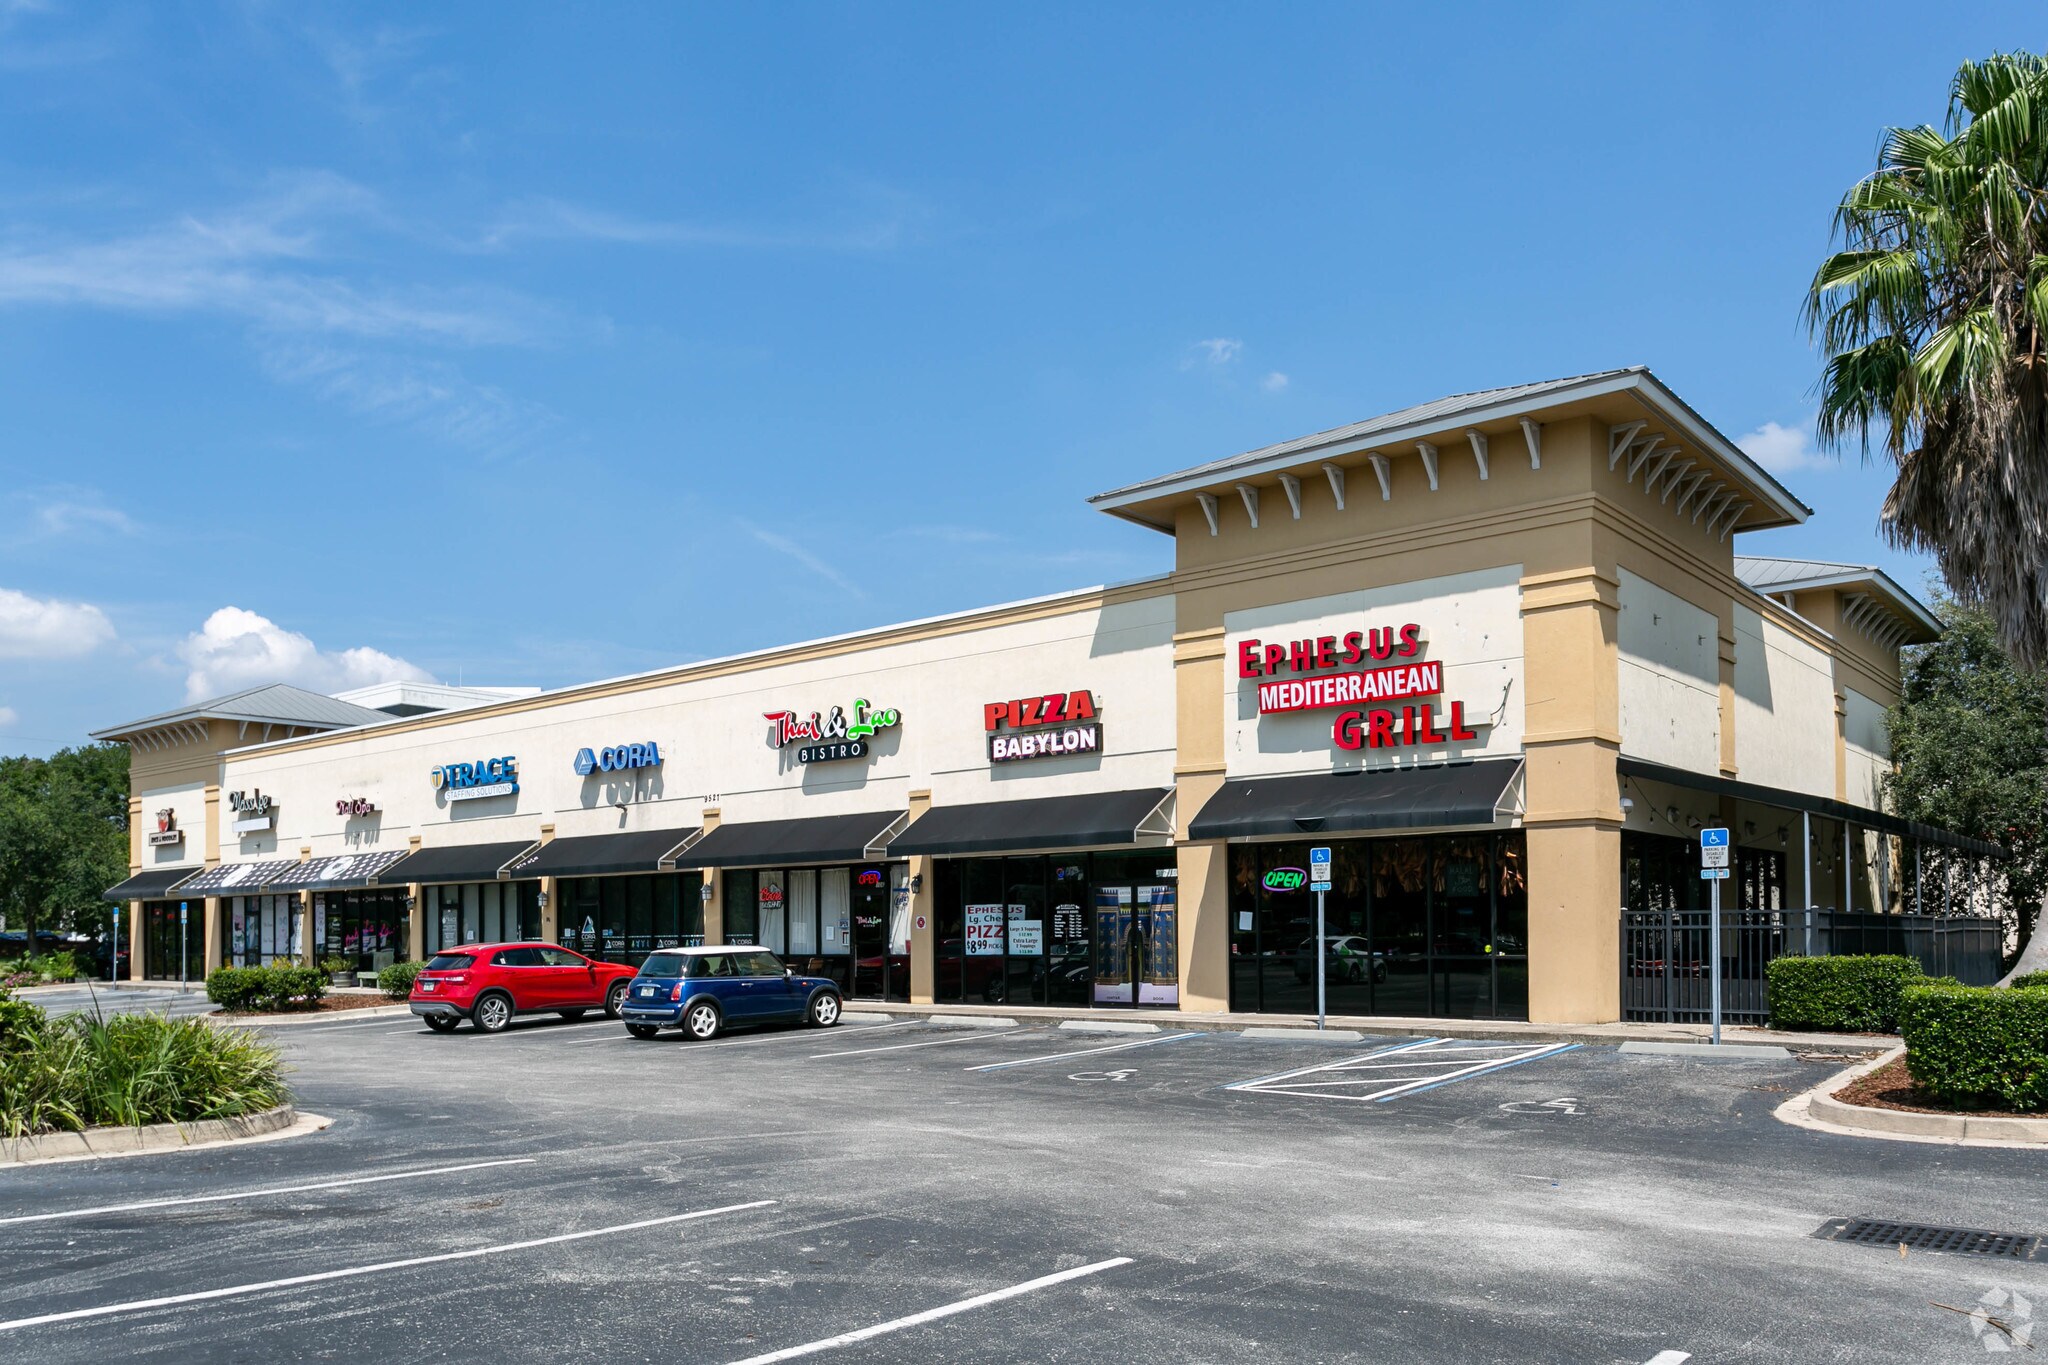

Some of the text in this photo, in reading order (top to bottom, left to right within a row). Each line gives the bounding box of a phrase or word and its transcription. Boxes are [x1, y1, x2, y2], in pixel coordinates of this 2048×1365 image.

[1238, 623, 1420, 679] EPHESUS
[1261, 664, 1438, 711] MEDITERRANEAN
[762, 697, 899, 748] Thai & Lao
[984, 689, 1096, 732] PIZZA
[1333, 700, 1477, 751] GRILL
[600, 741, 660, 772] CORA
[801, 743, 861, 762] BISTRO
[993, 727, 1096, 759] BABYLON
[446, 756, 516, 788] TRACE
[446, 784, 511, 800] STAFFING SOLUTIONS
[858, 873, 879, 885] OPEN
[1265, 871, 1303, 888] OPEN
[967, 925, 1004, 939] PIZZ
[969, 916, 982, 924] Lg.
